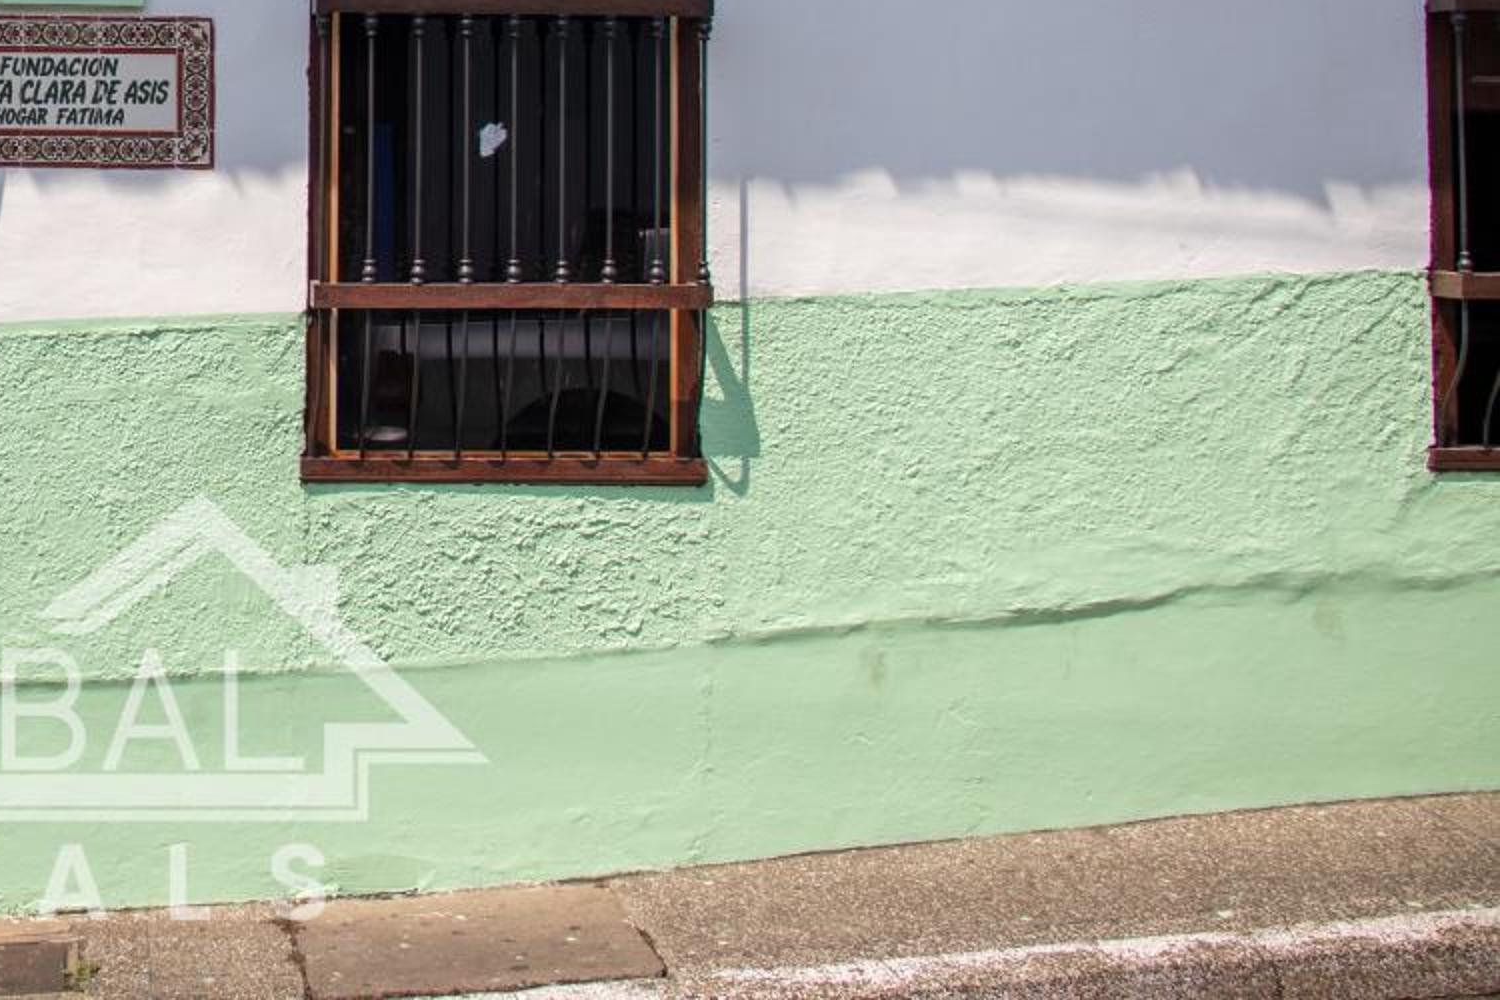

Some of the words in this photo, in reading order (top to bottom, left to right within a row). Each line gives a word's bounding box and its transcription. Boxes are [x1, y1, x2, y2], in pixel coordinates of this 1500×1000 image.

[20, 80, 86, 105] CLARA
[92, 80, 122, 105] DE
[124, 80, 169, 105] ASIS
[56, 108, 126, 126] FATIMA
